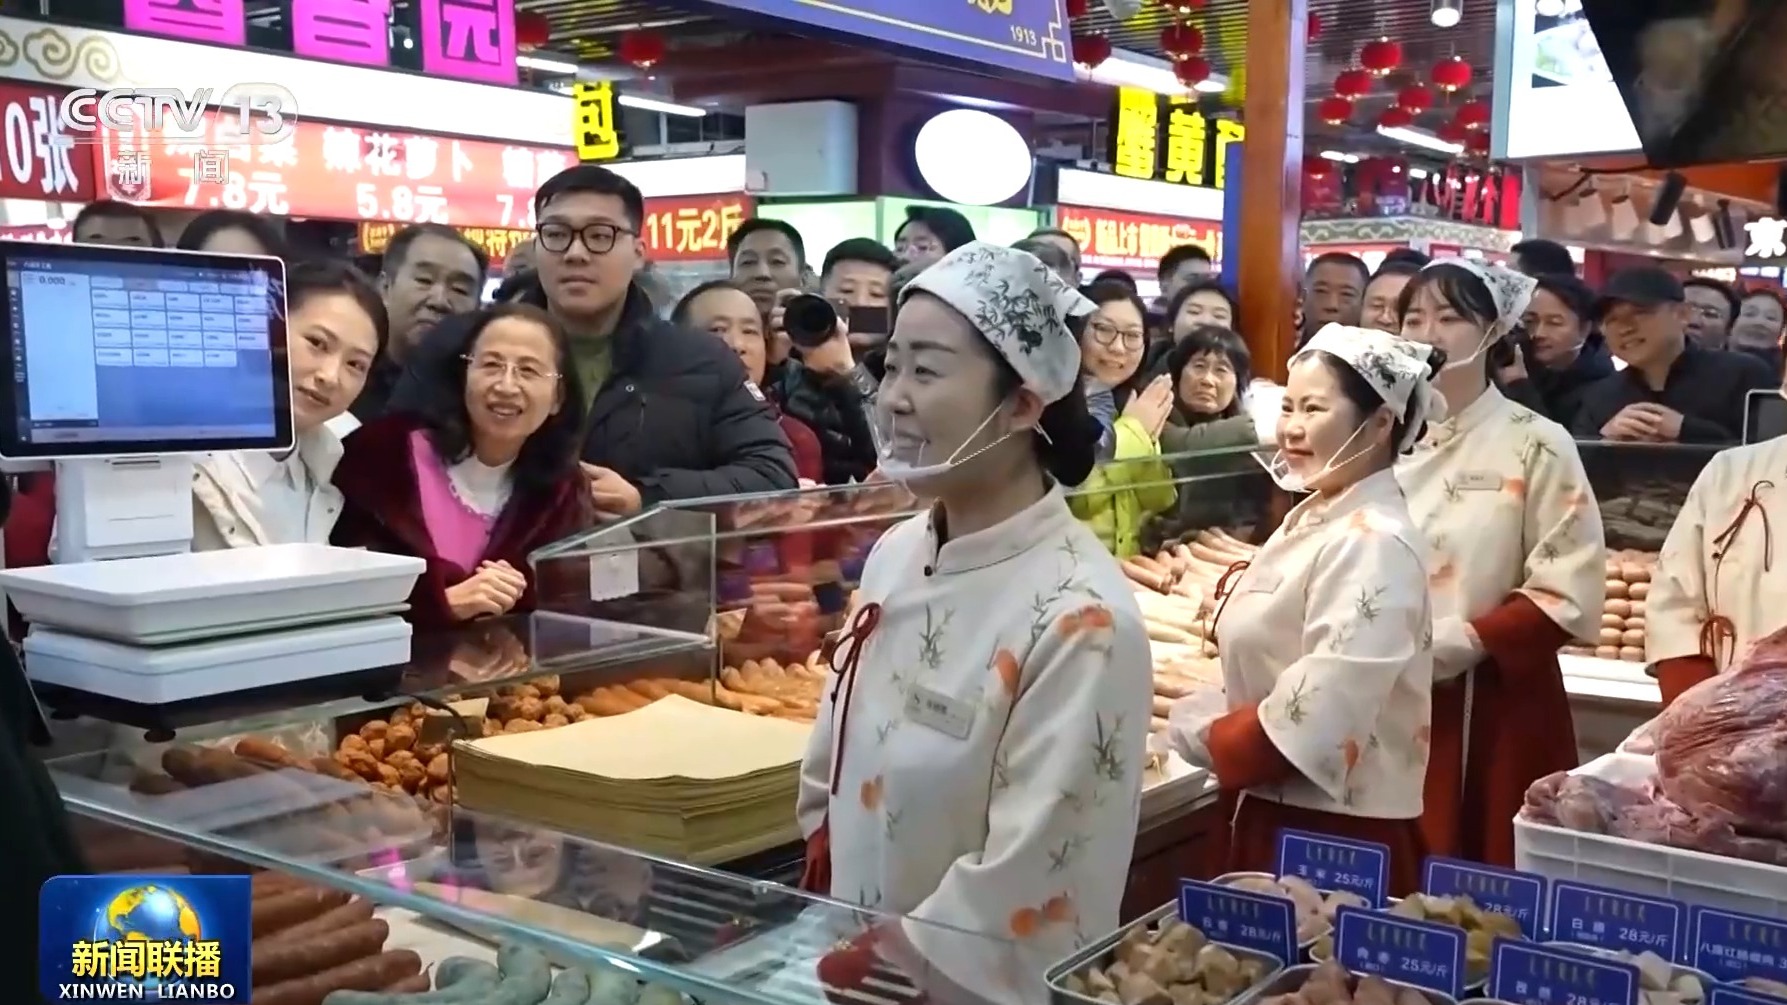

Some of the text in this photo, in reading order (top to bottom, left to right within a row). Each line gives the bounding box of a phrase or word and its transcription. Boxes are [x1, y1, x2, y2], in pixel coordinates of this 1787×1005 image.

[1009, 24, 1038, 46] 1913
[177, 167, 290, 215] 7.8元
[356, 182, 449, 224] 5.8元
[647, 203, 743, 253] 11元2斤
[1334, 872, 1375, 890] 25元/斤
[1619, 927, 1669, 947] 28元/斤
[1401, 956, 1448, 978] 25元/斤
